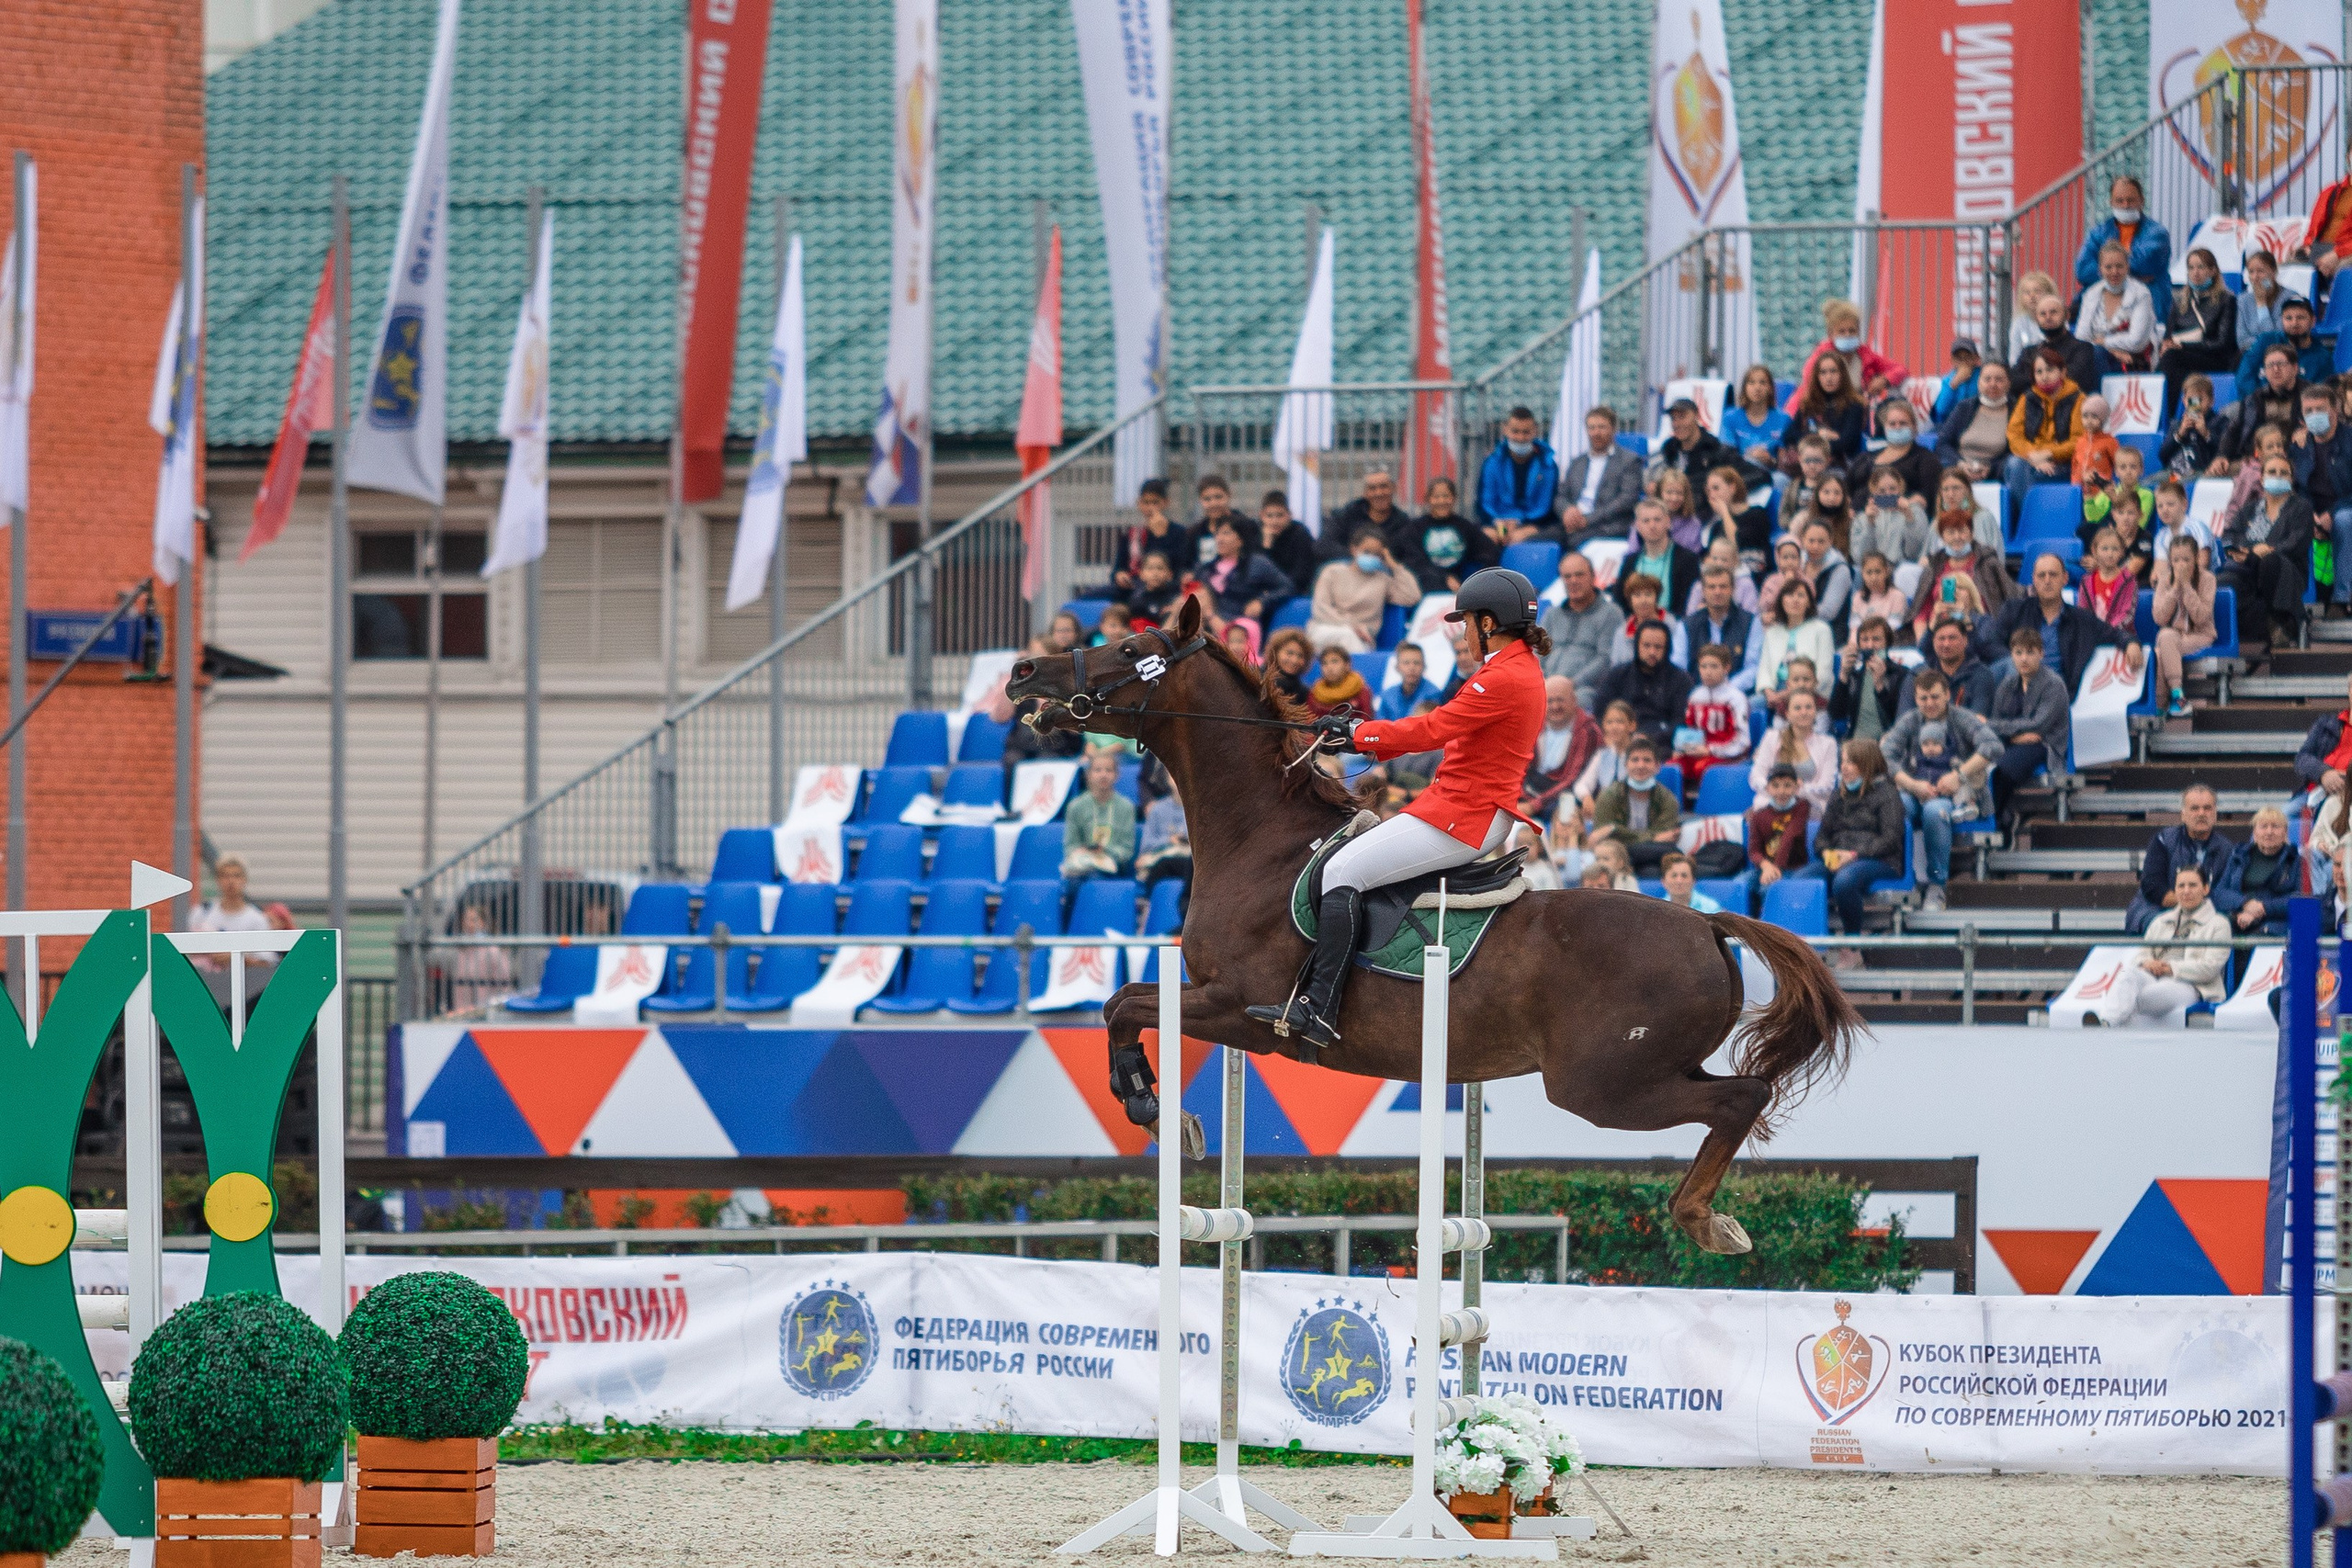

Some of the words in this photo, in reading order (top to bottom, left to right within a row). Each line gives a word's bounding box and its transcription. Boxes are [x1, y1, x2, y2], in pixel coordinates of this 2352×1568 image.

[894, 1316, 1030, 1346] ФЕДЕРАЦИЯ
[893, 1348, 1025, 1374] ПЯТИБОРЬЯ
[1036, 1353, 1114, 1379] РОССИИ
[1519, 1351, 1628, 1377] MODERN
[1899, 1344, 1965, 1363] КУБОК
[1970, 1345, 2102, 1368] ПРЕЗИДЕНТА
[1899, 1372, 2037, 1395] РОССИЙСКОЙ
[2042, 1376, 2167, 1400] ФЕДЕРАЦИИ
[1573, 1385, 1724, 1412] FEDERATION
[1317, 1415, 1350, 1427] RMPF
[1894, 1406, 1926, 1424] ПО
[1931, 1407, 2103, 1427] СОВРЕМЕННОМУ
[2104, 1409, 2232, 1427] ПЯТИБОРЬЮ
[2236, 1409, 2287, 1427] 2021
[1811, 1437, 1860, 1446] FEDERATION
[1816, 1428, 1851, 1437] RUSSIAN
[1810, 1446, 1862, 1454] PRESIDENT'S
